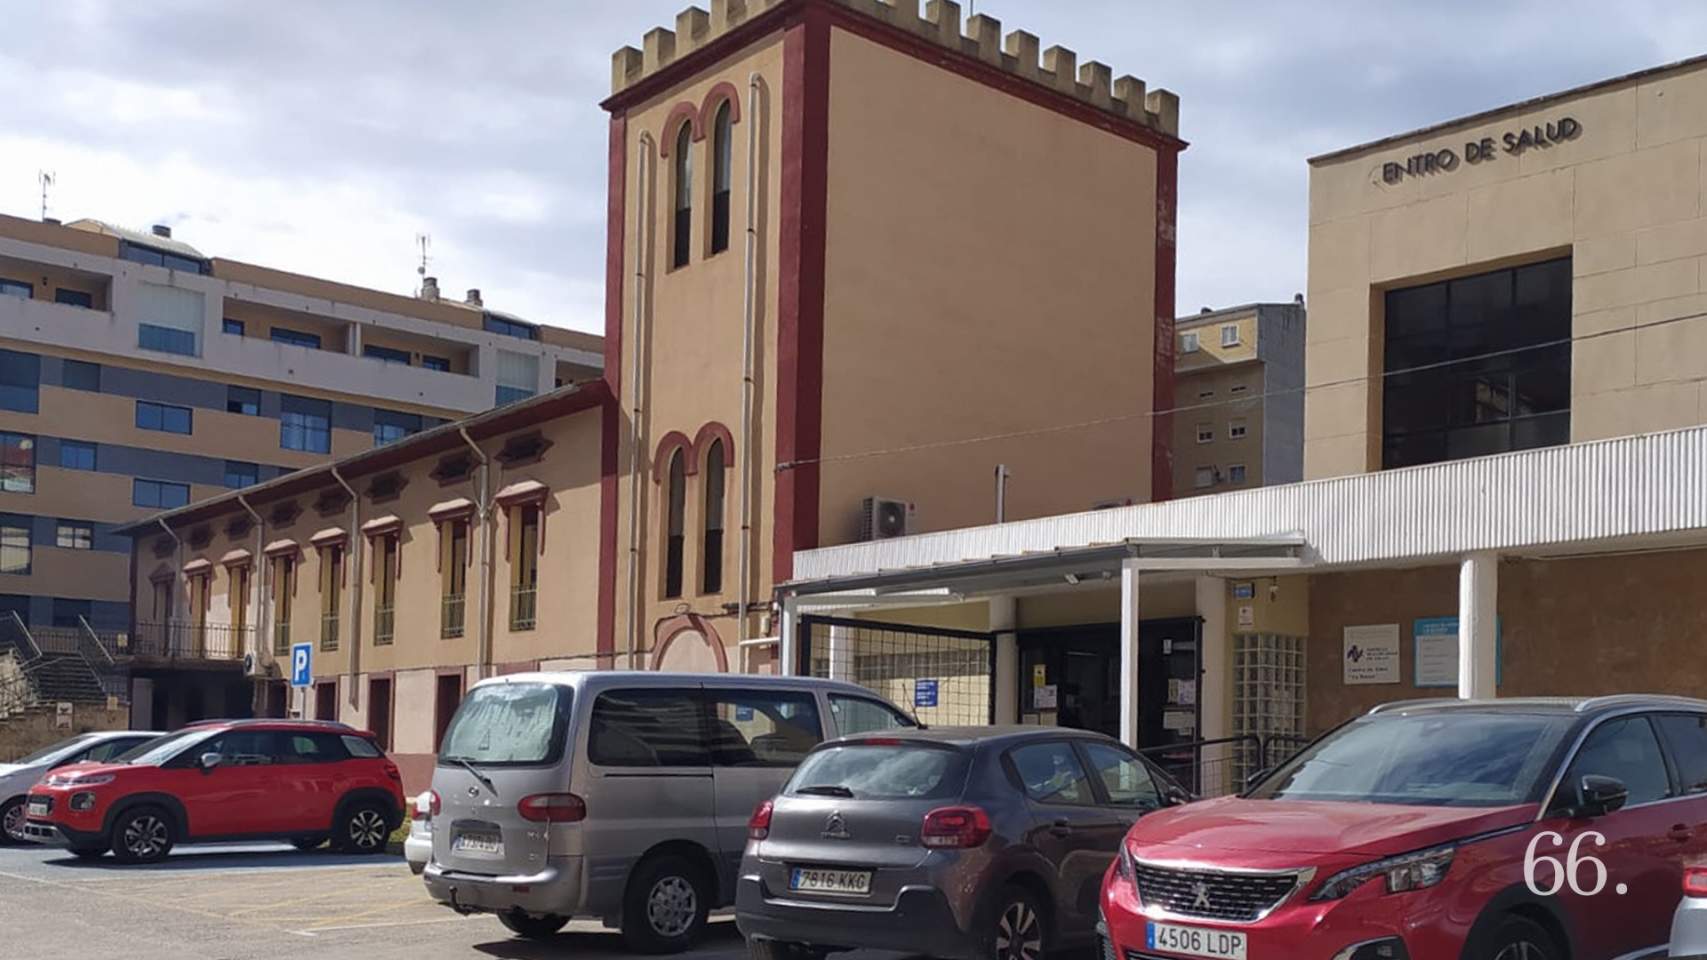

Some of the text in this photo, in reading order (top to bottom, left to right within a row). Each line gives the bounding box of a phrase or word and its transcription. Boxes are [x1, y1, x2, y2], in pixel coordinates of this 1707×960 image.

[1465, 137, 1495, 163] DE
[1502, 117, 1579, 153] SALUD
[294, 649, 308, 683] P
[1158, 927, 1242, 956] 4506 LDP
